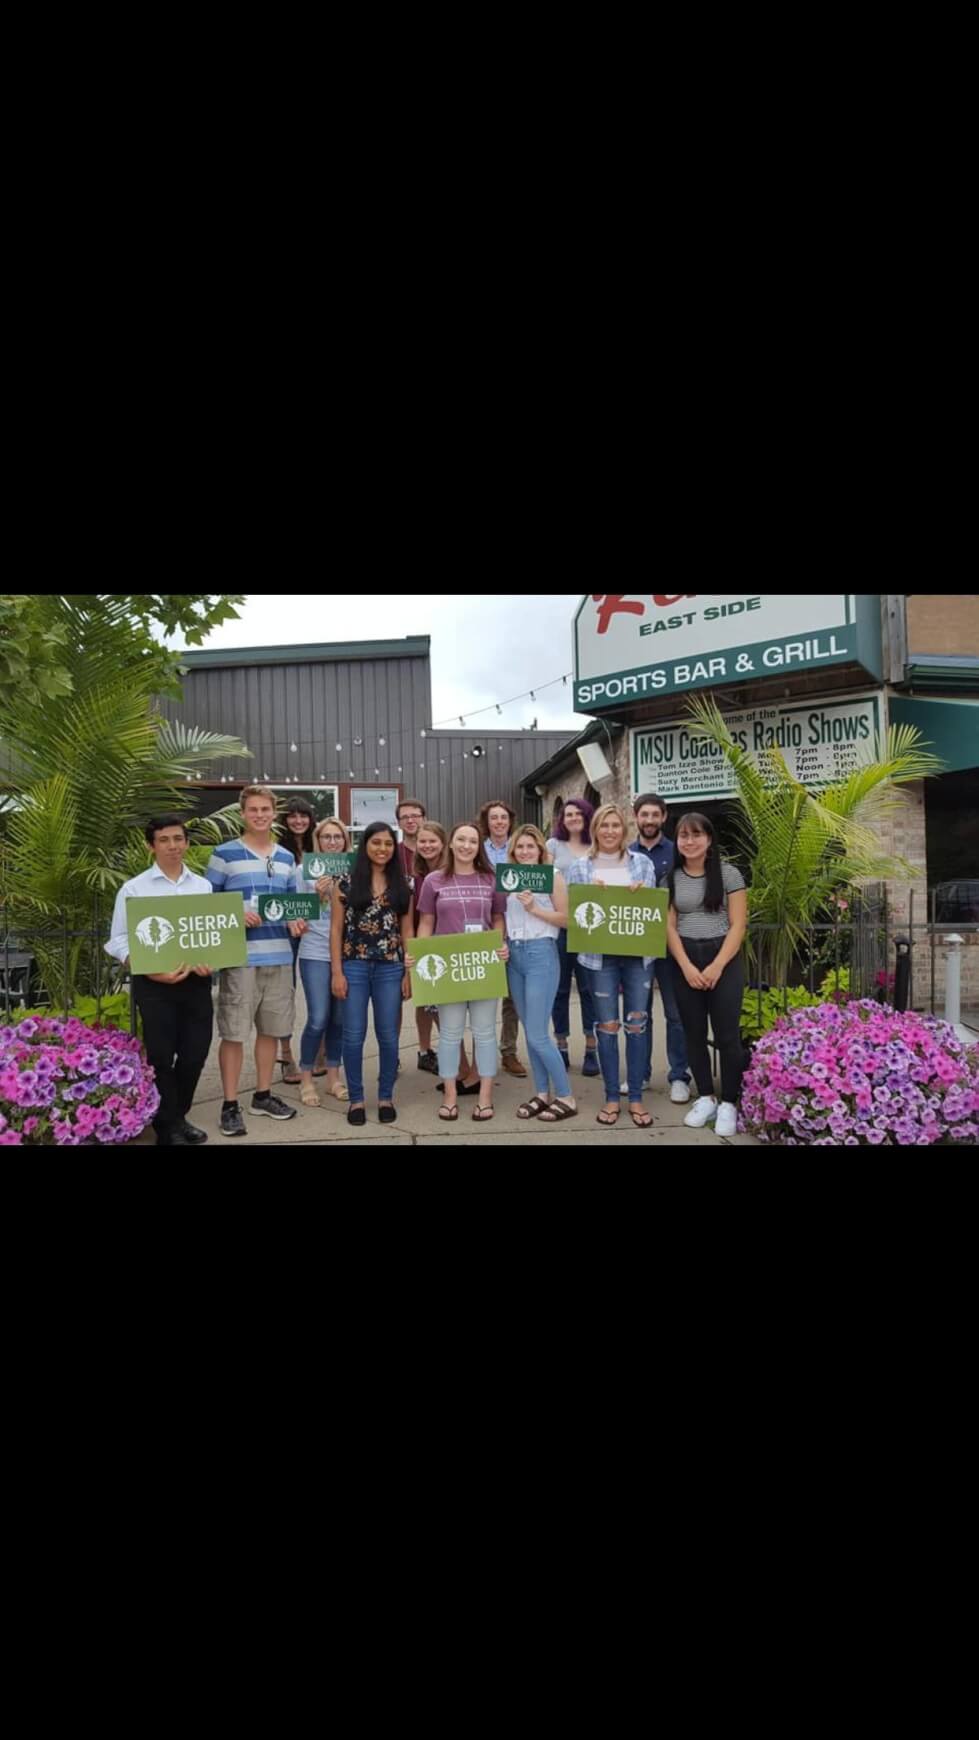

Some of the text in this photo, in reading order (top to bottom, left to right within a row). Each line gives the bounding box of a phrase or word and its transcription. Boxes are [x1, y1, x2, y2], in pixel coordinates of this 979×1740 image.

[639, 612, 697, 637] EAST
[704, 597, 761, 621] SIDE
[578, 635, 848, 703] SPORTS BAR & GRILL
[746, 711, 756, 721] of
[760, 709, 776, 719] the
[641, 733, 674, 765] MSU
[753, 717, 802, 751] Radio
[808, 712, 870, 745] Shows
[795, 748, 818, 756] 7pm
[657, 770, 688, 778] Danton
[690, 766, 711, 774] Cole
[681, 773, 724, 783] Merchant
[796, 763, 824, 771] Noon
[683, 781, 724, 790] Dantonio
[796, 772, 819, 780] 7pm
[519, 871, 547, 880] SIERRA
[520, 879, 544, 888] CLUB
[283, 900, 312, 909] SIERRA
[285, 908, 310, 916] CLUB
[609, 905, 662, 922] SIERRA
[178, 913, 239, 932] SIERRA
[608, 920, 645, 936] CLUB
[179, 932, 222, 949] CLUB
[450, 950, 500, 967] SIERRA
[451, 966, 486, 982] CLUB
